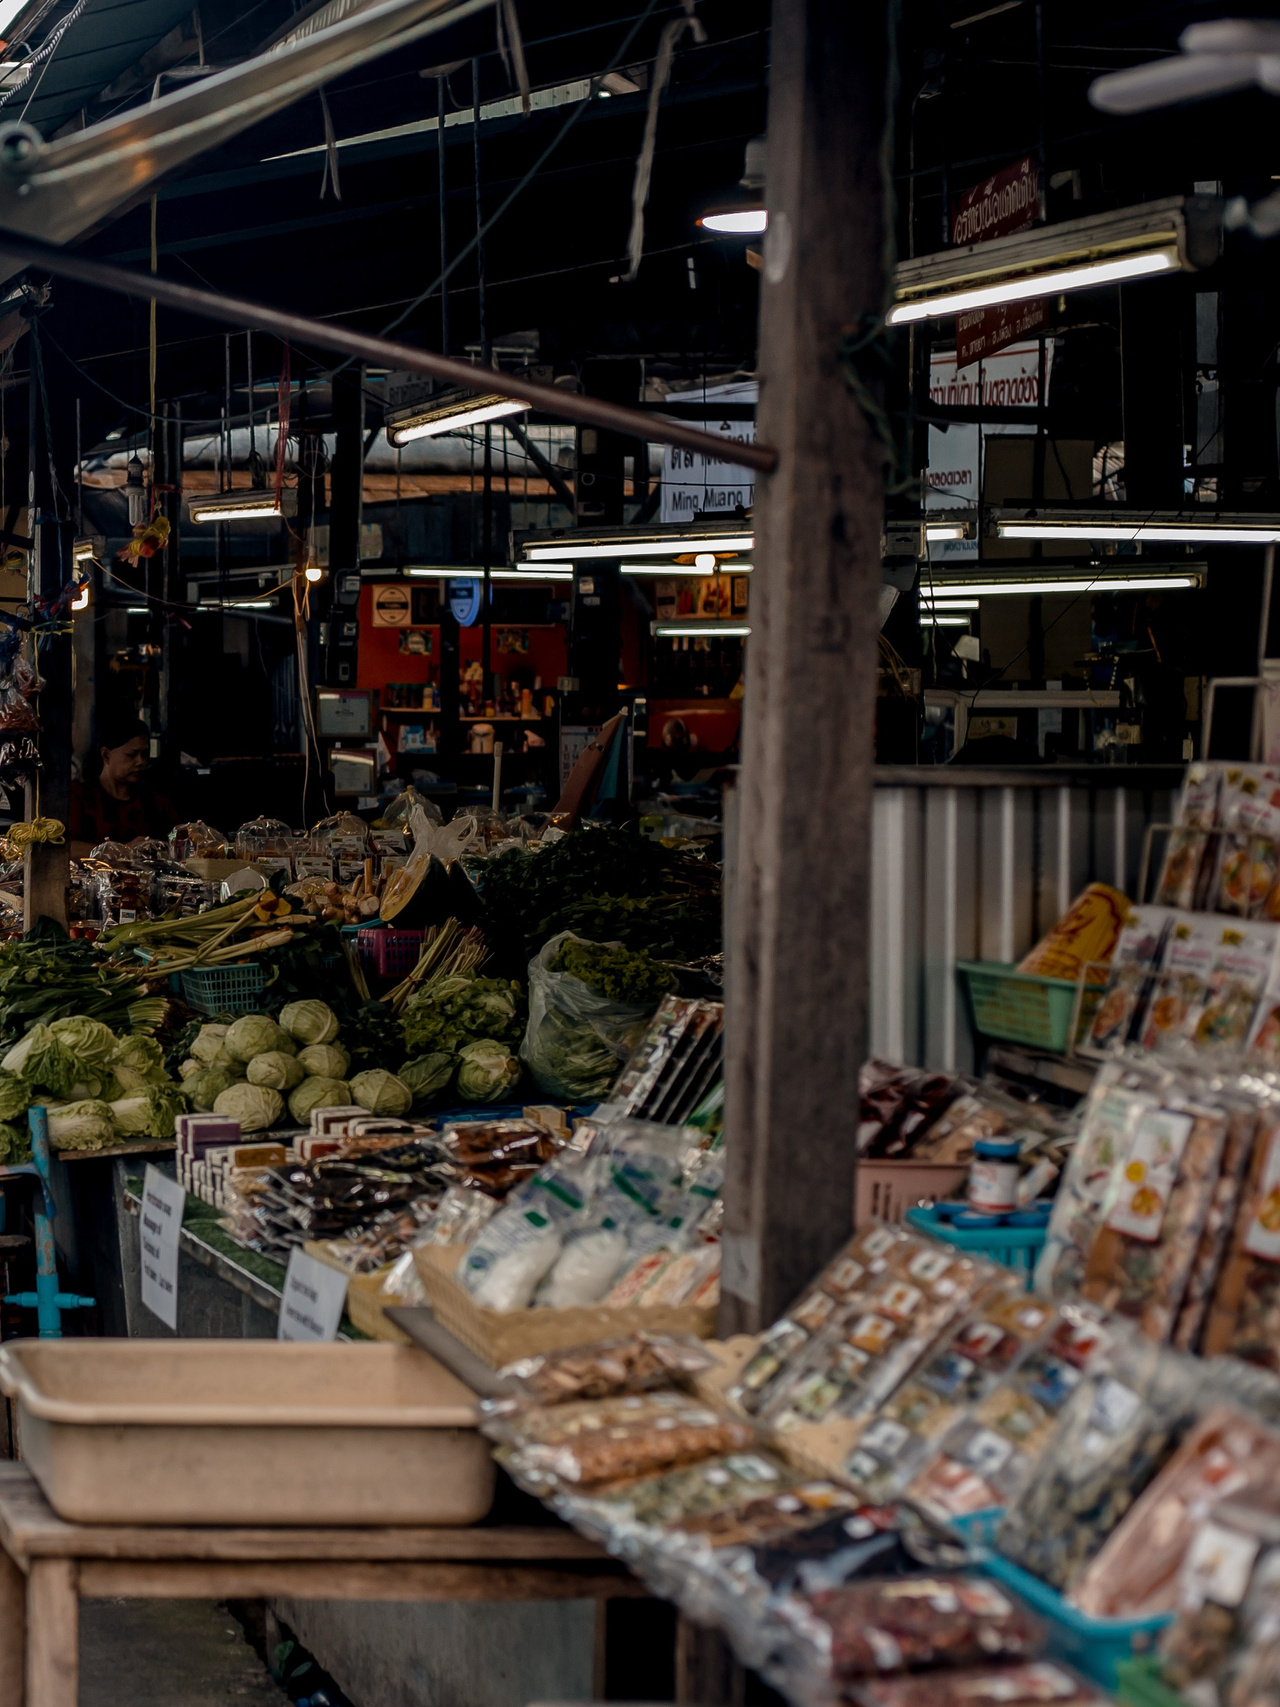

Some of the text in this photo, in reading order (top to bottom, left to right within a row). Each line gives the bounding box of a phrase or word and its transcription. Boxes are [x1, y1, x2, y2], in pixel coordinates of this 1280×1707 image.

[927, 470, 972, 487] ตลอดเวลา
[672, 490, 699, 512] Ming
[705, 488, 743, 510] Muang
